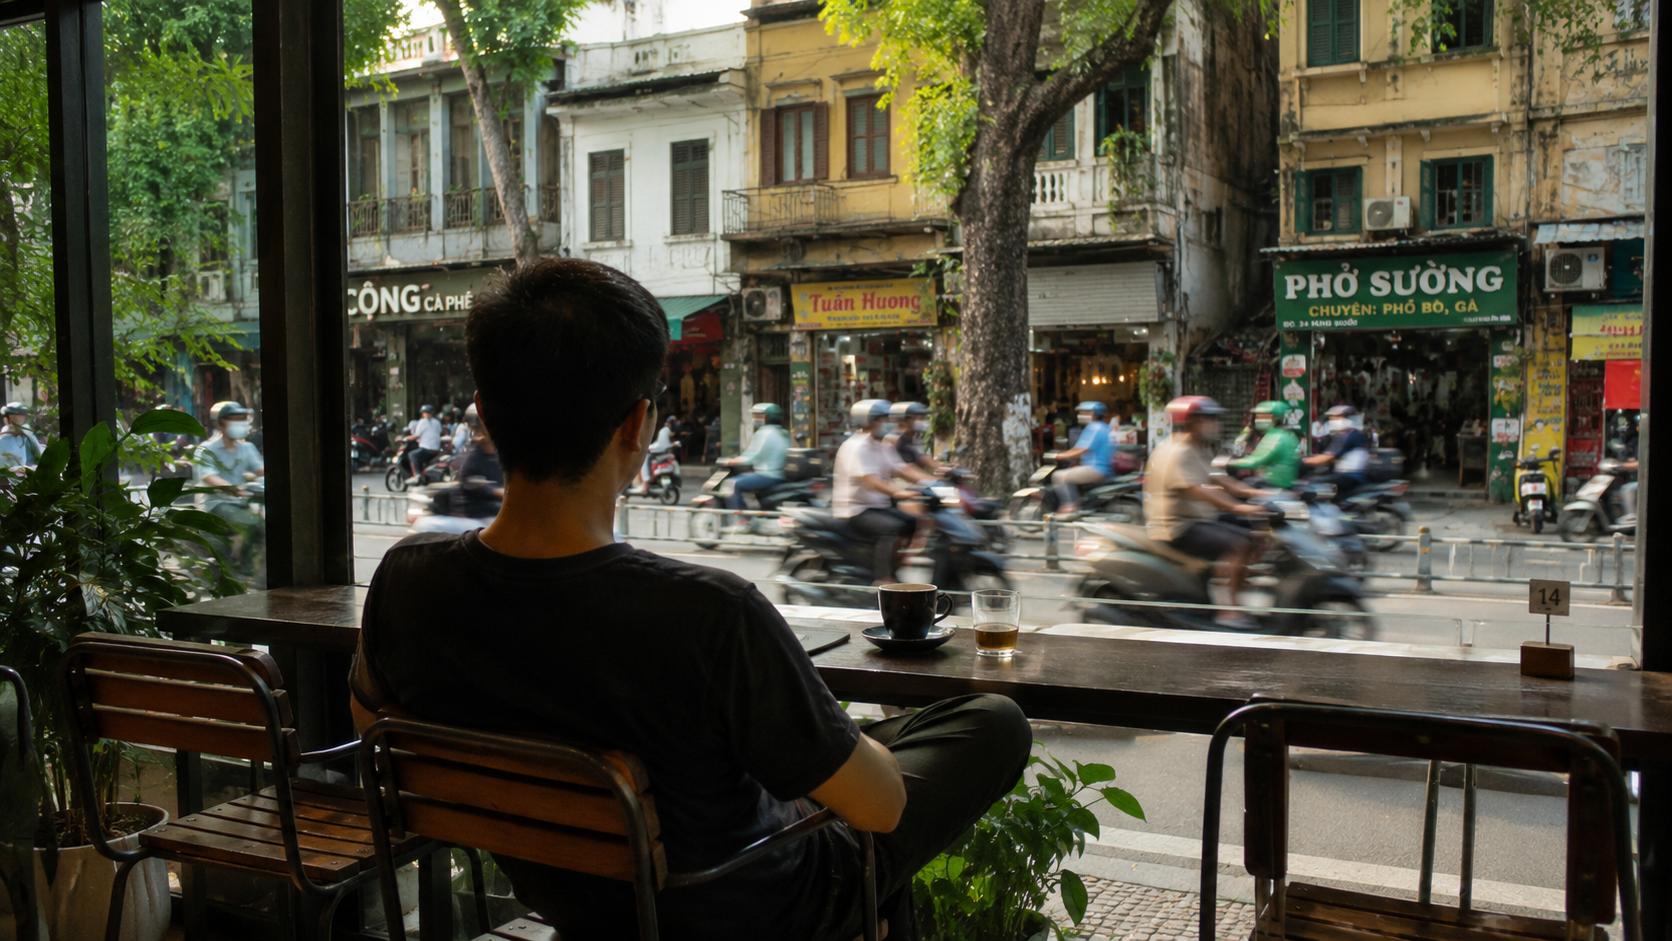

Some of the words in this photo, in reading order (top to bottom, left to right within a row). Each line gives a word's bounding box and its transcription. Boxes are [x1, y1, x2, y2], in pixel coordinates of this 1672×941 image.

[1284, 262, 1359, 300] PHỞ
[1370, 260, 1504, 296] SƯỜNG
[1538, 588, 1562, 606] 14
